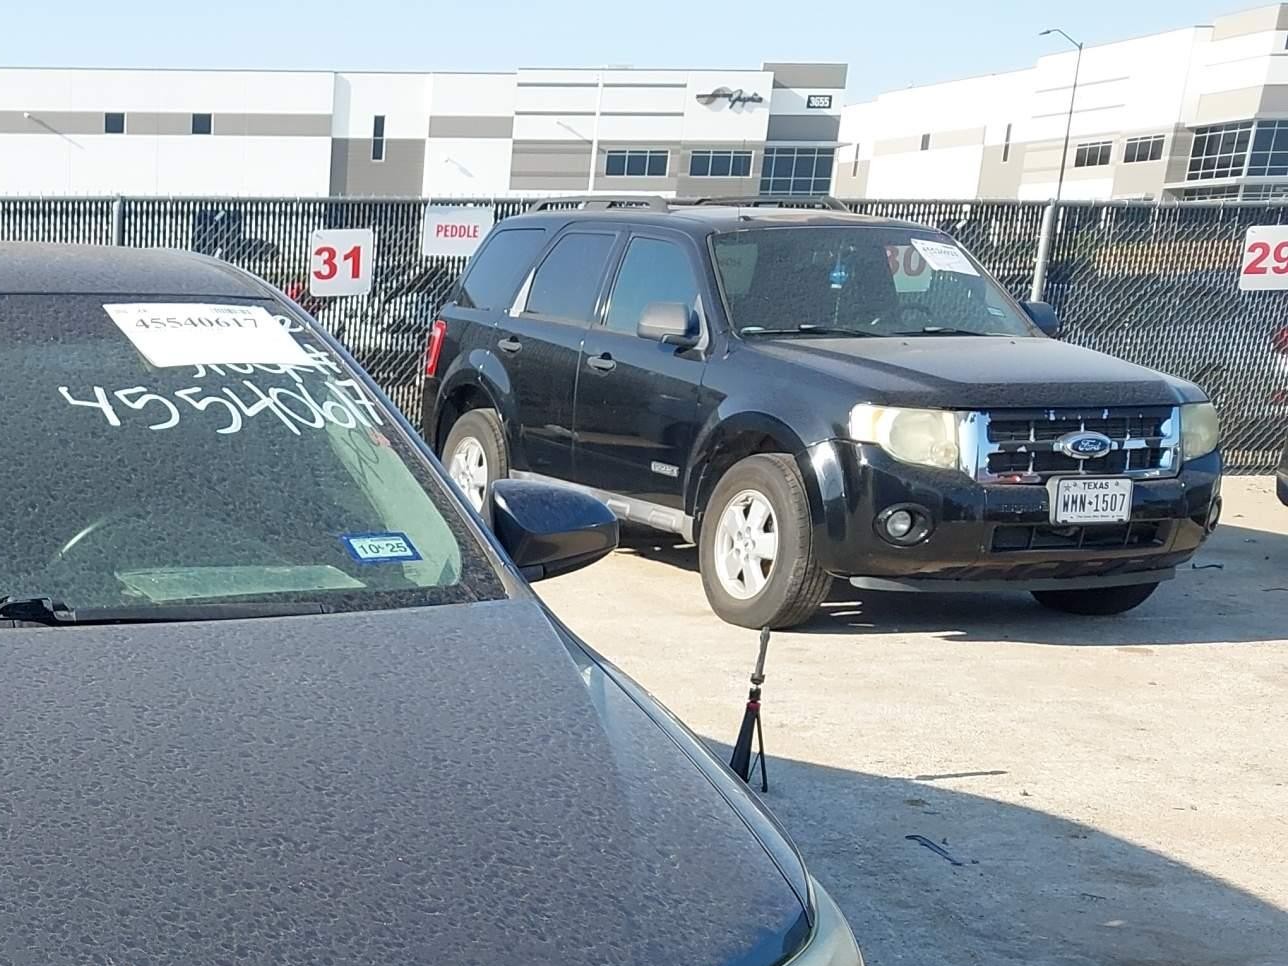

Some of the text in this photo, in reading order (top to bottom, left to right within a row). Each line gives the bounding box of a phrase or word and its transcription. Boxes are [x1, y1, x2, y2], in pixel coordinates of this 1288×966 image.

[808, 96, 830, 108] 3655
[436, 224, 479, 238] PEDDLE
[313, 245, 361, 280] 31
[1243, 240, 1288, 275] 29
[135, 317, 259, 330] 45540617
[58, 378, 384, 436] 45540617
[1078, 440, 1101, 451] Ford
[1082, 481, 1110, 491] TEXAS
